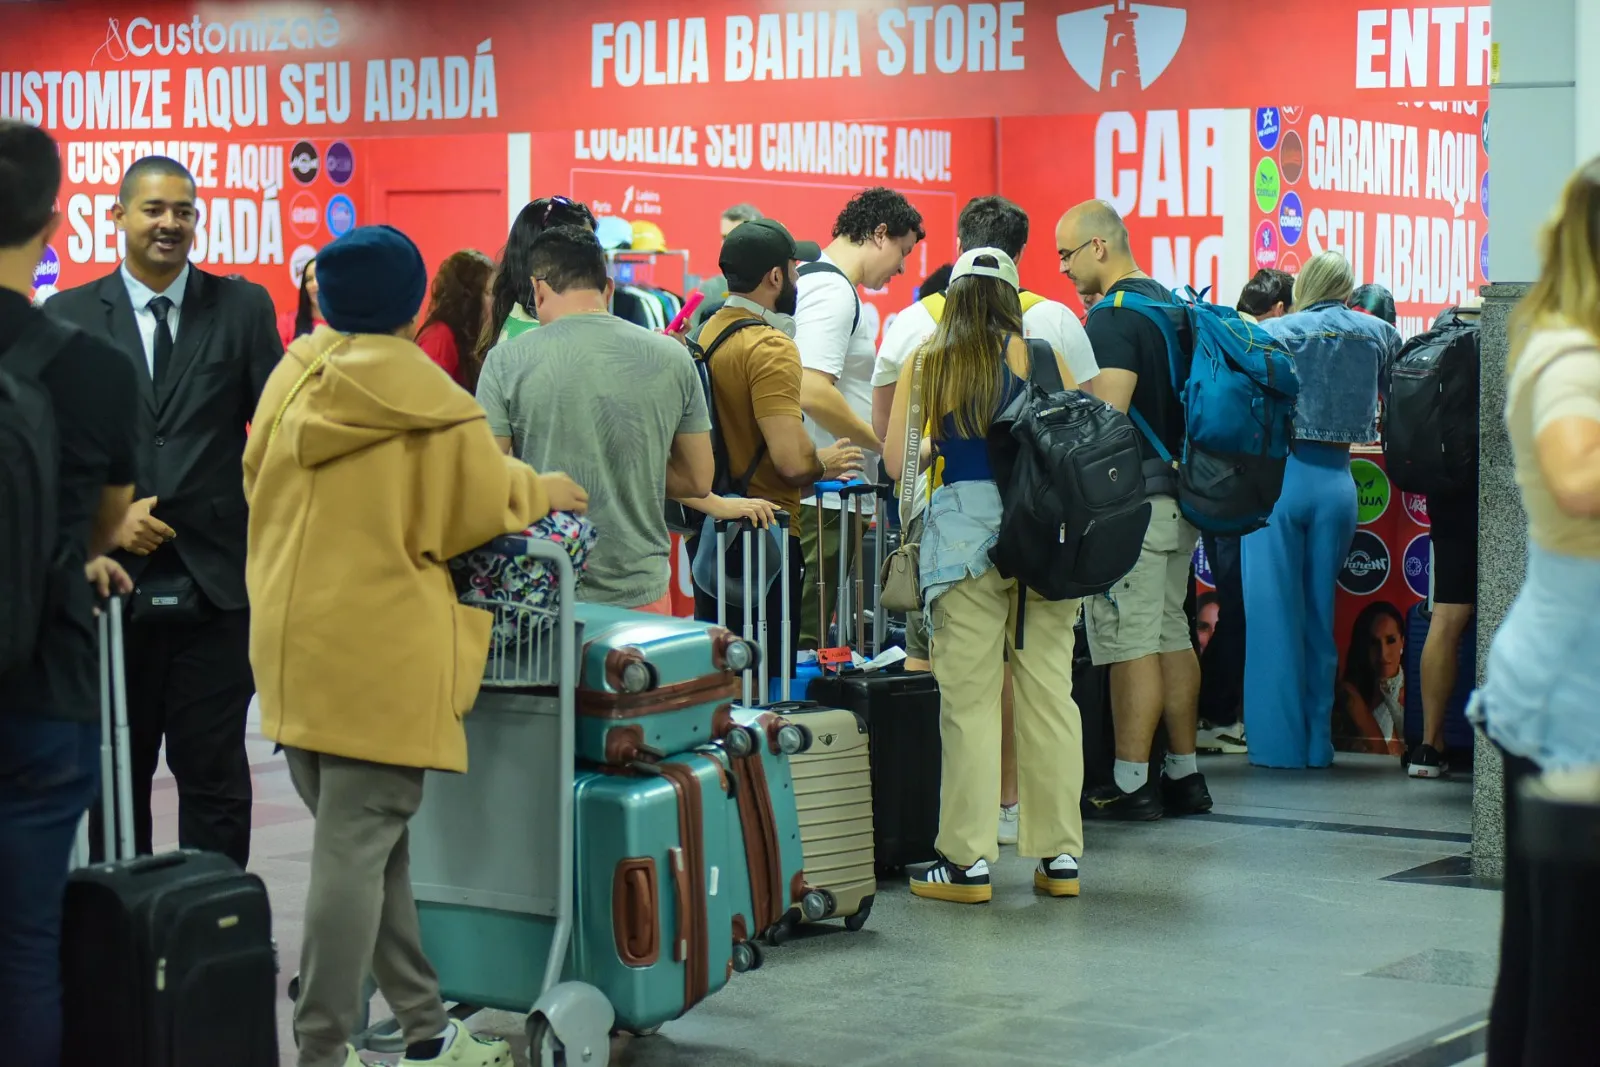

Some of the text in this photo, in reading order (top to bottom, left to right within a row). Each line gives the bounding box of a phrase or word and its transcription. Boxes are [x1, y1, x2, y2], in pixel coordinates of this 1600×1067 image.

[126, 9, 340, 57] Customizaê
[590, 1, 1025, 88] FOLIA BAHIA STORE
[183, 64, 268, 132] AQUI
[279, 61, 351, 125] SEU
[364, 38, 498, 122] ABADÁ
[224, 144, 284, 192] AQUI
[759, 121, 889, 178] CAMAROTE
[893, 128, 953, 183] AQUI!
[1307, 112, 1477, 209] GARANTA AQUI
[67, 192, 126, 264] SE
[1373, 200, 1477, 305] ABADÁ!
[903, 428, 919, 502] LOUIS VUITTON
